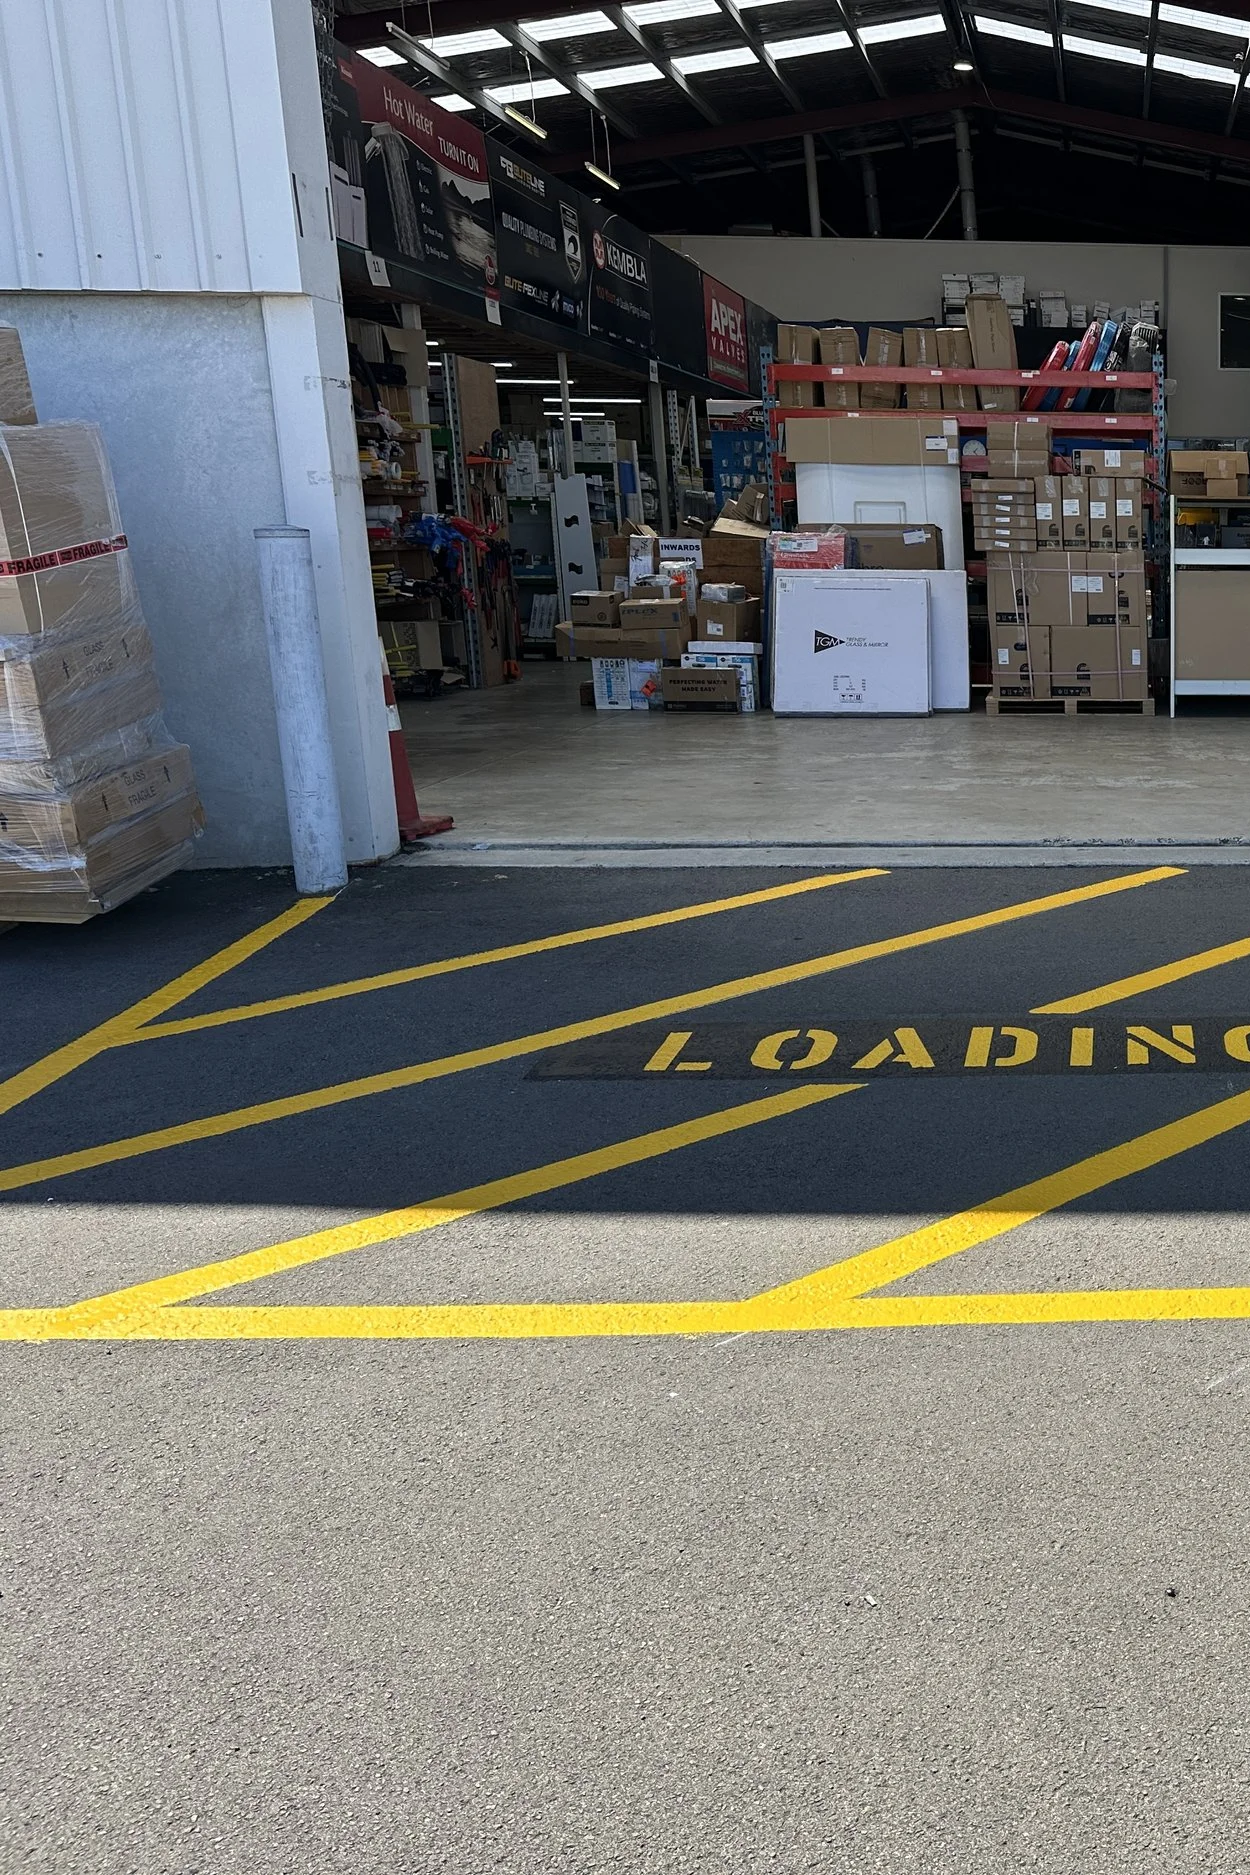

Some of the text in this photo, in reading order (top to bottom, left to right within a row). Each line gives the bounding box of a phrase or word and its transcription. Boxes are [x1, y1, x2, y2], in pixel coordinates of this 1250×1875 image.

[383, 86, 434, 137] Hot Water
[438, 136, 460, 163] TURN
[467, 152, 480, 174] ON
[606, 242, 647, 284] KEMBLA
[711, 298, 744, 346] APEX
[711, 336, 745, 364] VALVES
[8, 555, 58, 574] FRAGILE
[73, 538, 112, 561] FRAGILE
[816, 636, 840, 647] TGM
[123, 768, 147, 787] GLASS
[128, 785, 158, 807] FRAGILE
